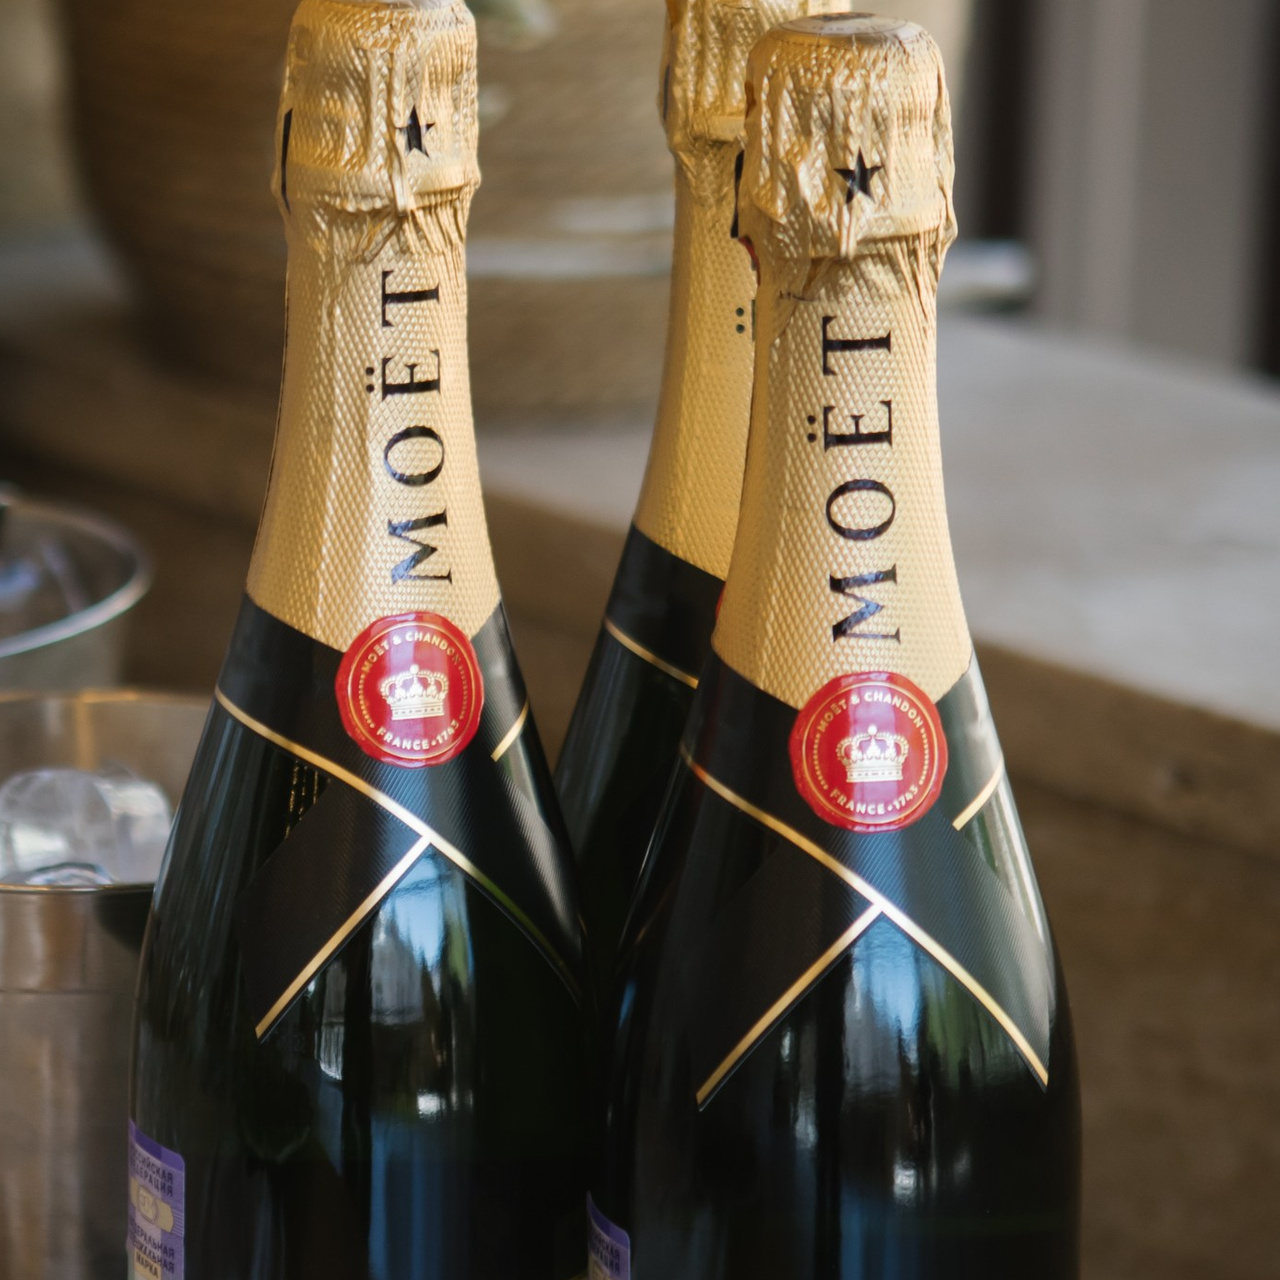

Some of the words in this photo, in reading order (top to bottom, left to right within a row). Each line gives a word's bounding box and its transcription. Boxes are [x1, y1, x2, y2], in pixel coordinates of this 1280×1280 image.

[366, 270, 452, 584] MOËT
[807, 316, 900, 643] MOËT
[405, 631, 461, 665] CHANDON
[850, 694, 860, 705] &
[864, 691, 923, 728] CHANDON
